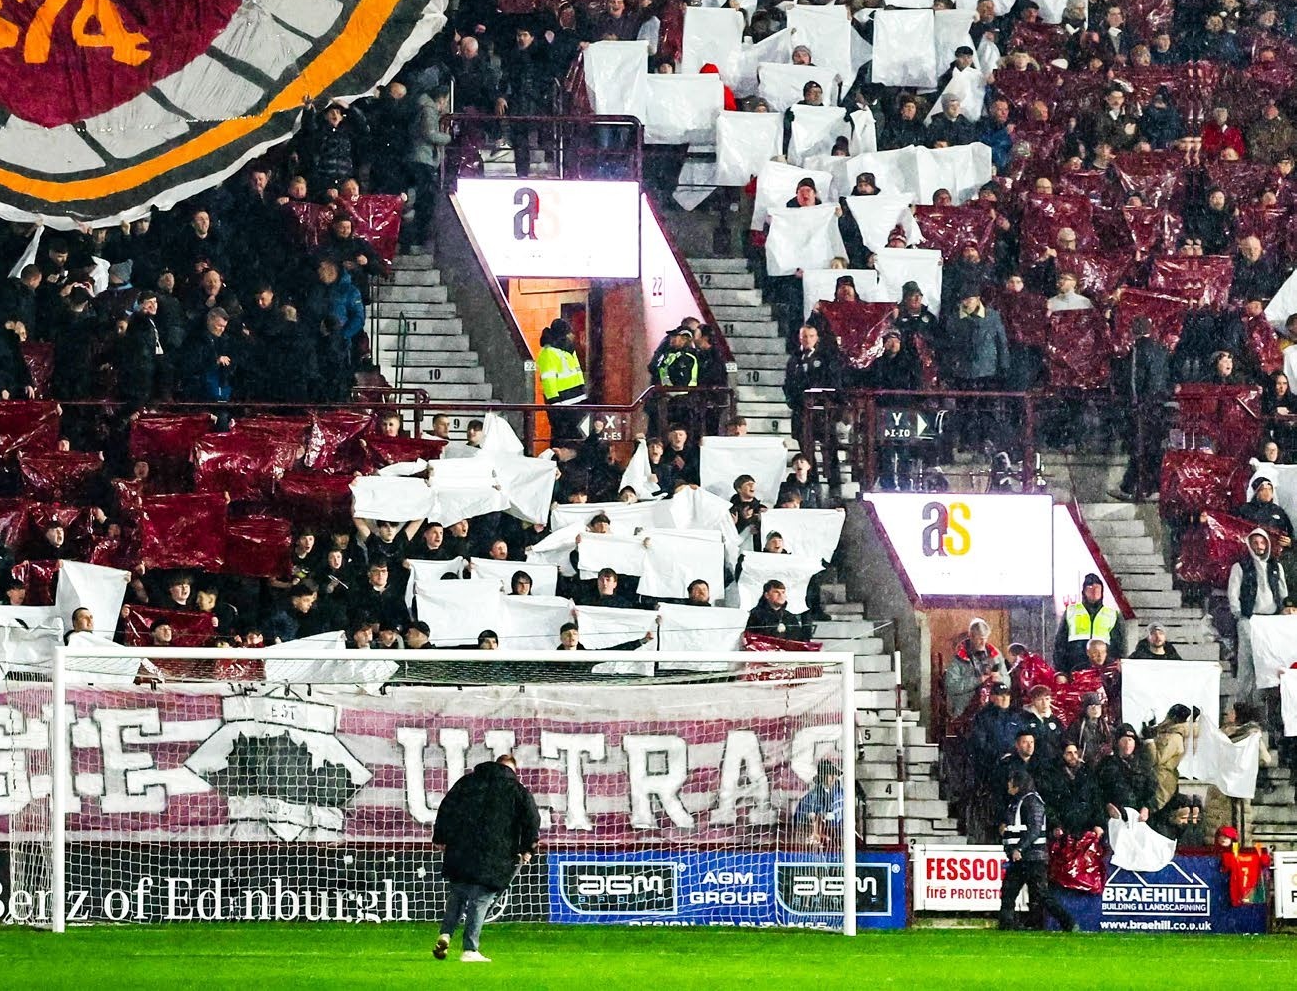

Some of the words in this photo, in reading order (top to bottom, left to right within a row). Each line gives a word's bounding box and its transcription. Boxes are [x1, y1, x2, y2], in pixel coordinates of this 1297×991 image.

[699, 275, 711, 285] 12
[407, 322, 417, 332] 11
[724, 324, 734, 334] 11
[429, 369, 441, 380] 10
[747, 372, 760, 383] 10
[453, 418, 460, 428] 9
[605, 415, 616, 429] X
[892, 412, 903, 426] Y
[921, 501, 971, 556] as
[864, 729, 871, 741] 5
[885, 783, 893, 796] 4
[703, 872, 753, 885] AGM
[104, 876, 153, 920] of
[689, 891, 766, 905] GROUP
[926, 886, 947, 899] fire
[1101, 902, 1137, 911] BUILDING
